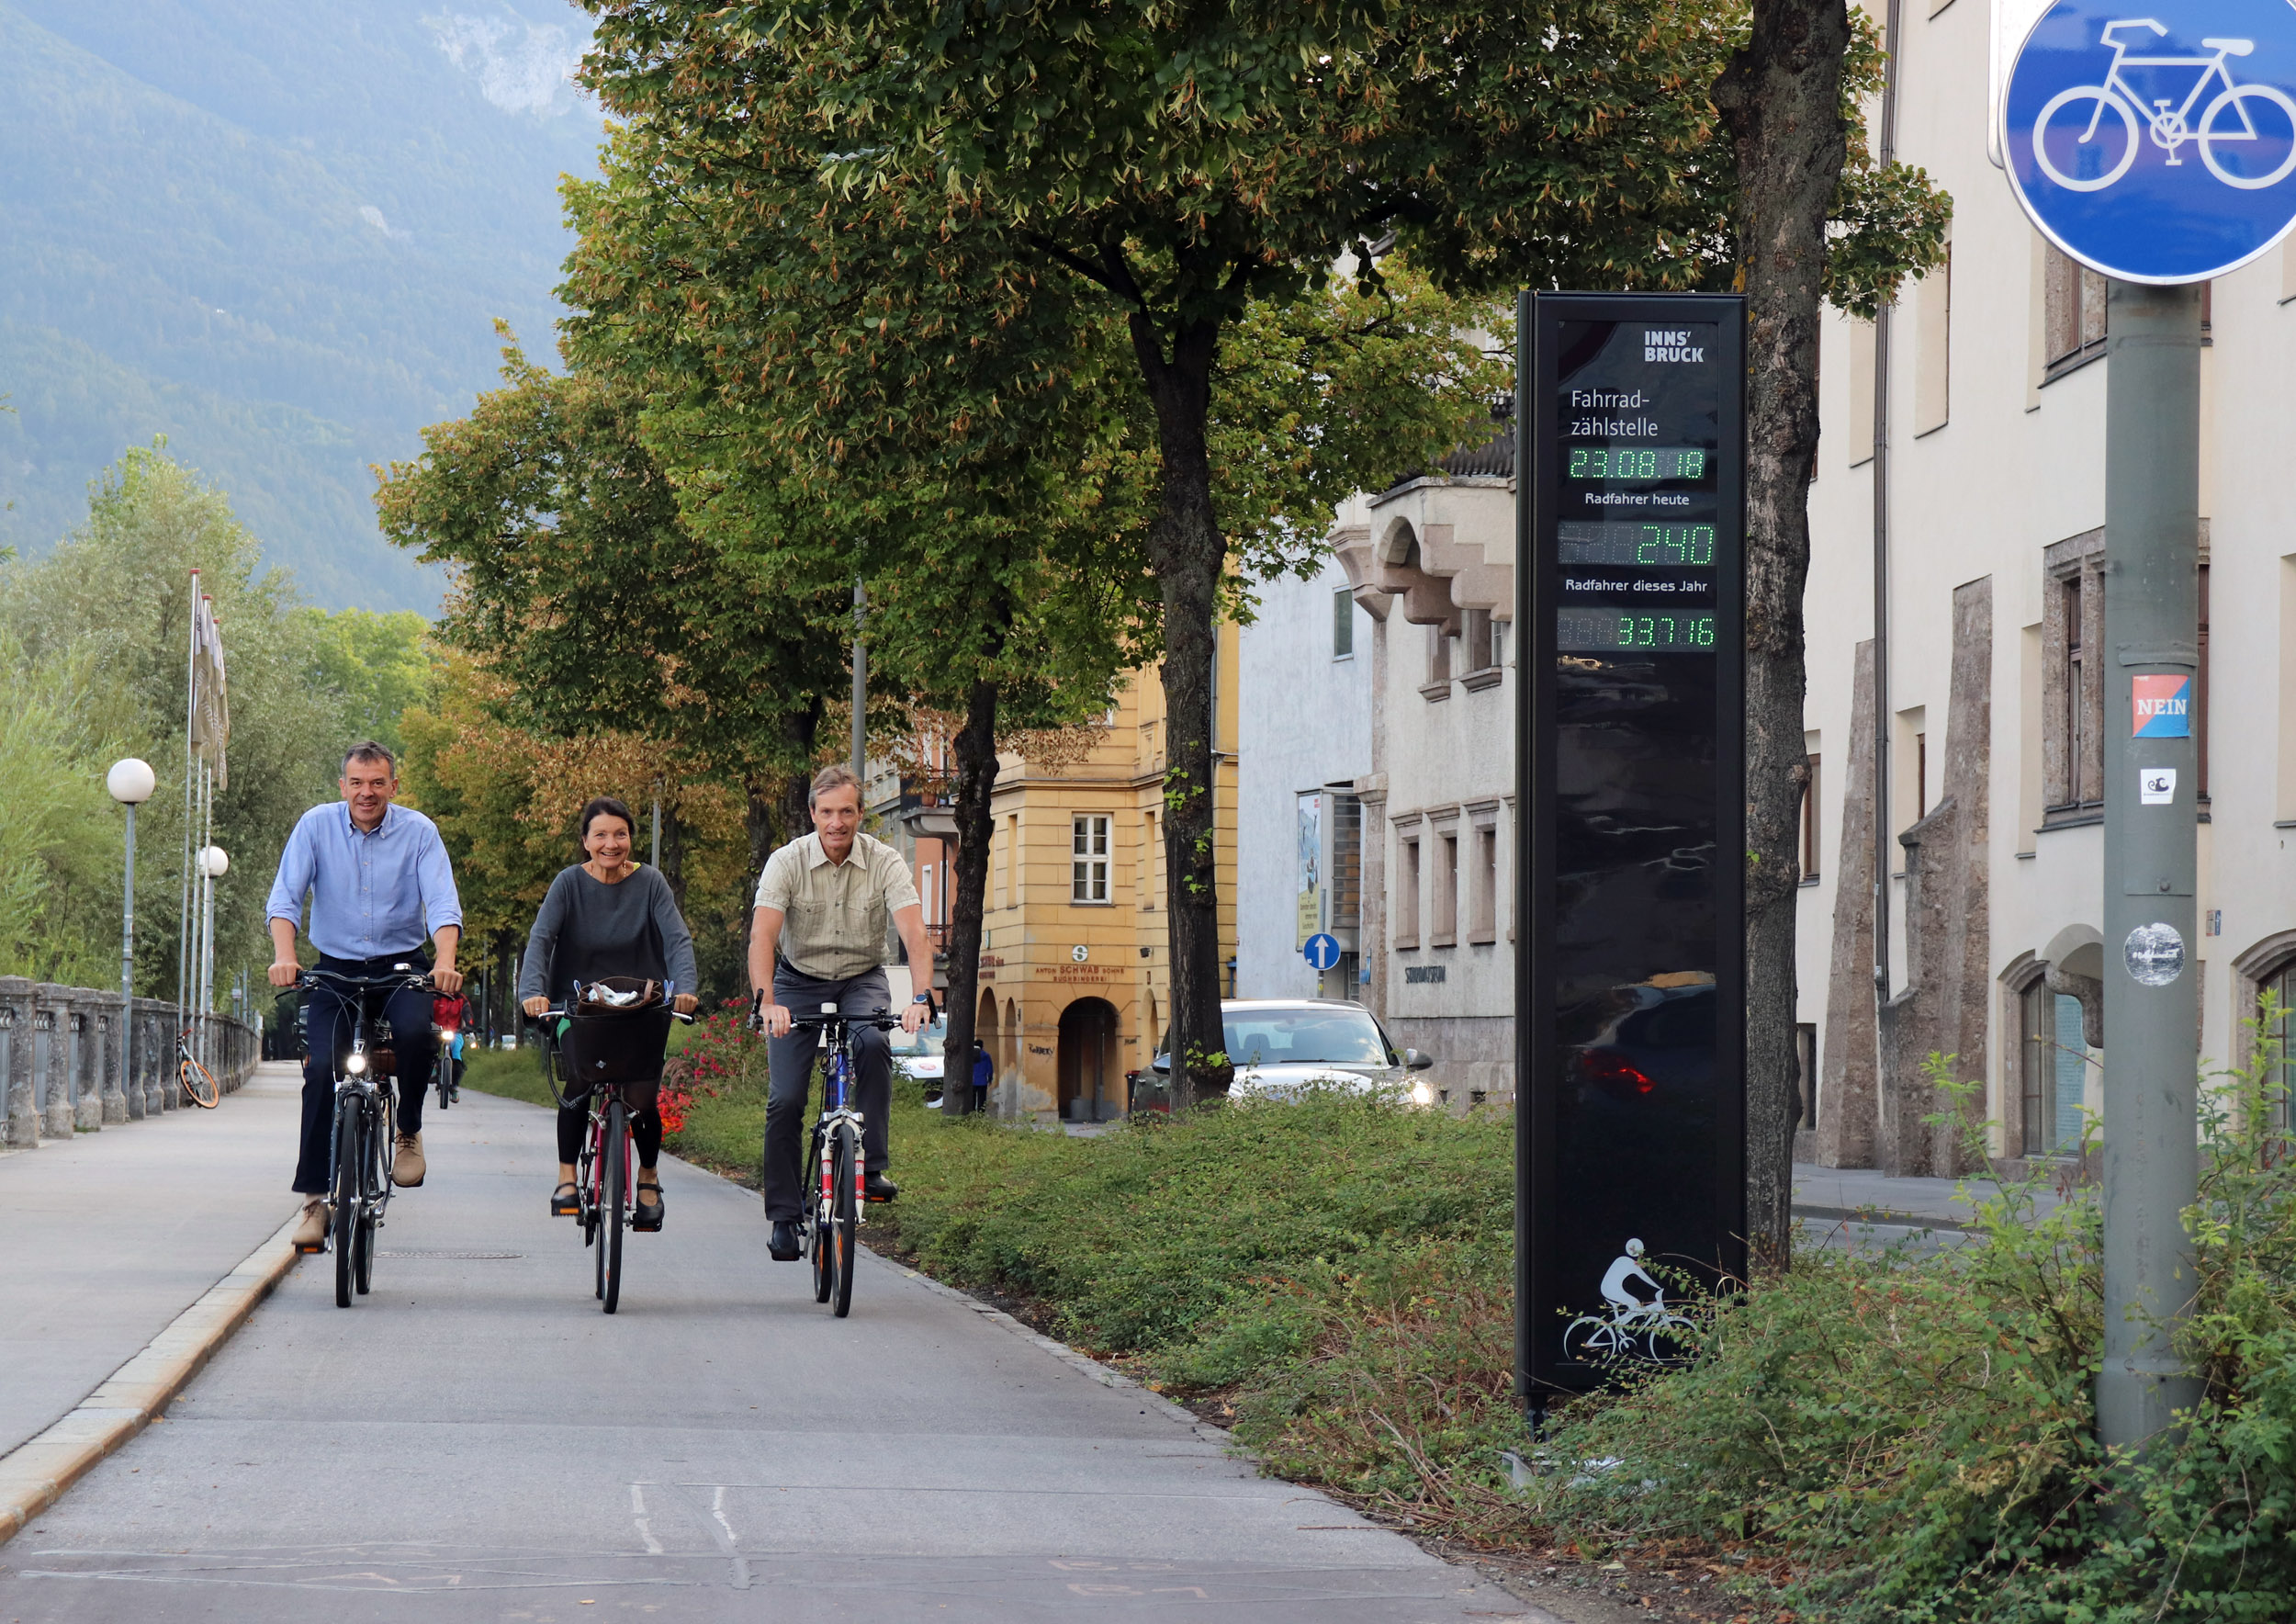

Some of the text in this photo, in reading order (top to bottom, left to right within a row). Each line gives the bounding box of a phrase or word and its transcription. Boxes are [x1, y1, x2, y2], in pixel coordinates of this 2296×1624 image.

[1644, 347, 1705, 363] BRUCK
[1570, 389, 1650, 408] Fahrrad-
[1570, 417, 1659, 436] zählstelle
[1570, 450, 1704, 479] 23.08.18
[1584, 492, 1690, 505] Radfahrer heute
[1638, 525, 1714, 565] 240
[1565, 580, 1707, 592] Radfahrer dieses Jahr
[2137, 698, 2188, 716] NEIN
[1059, 965, 1099, 974] SCHWAB
